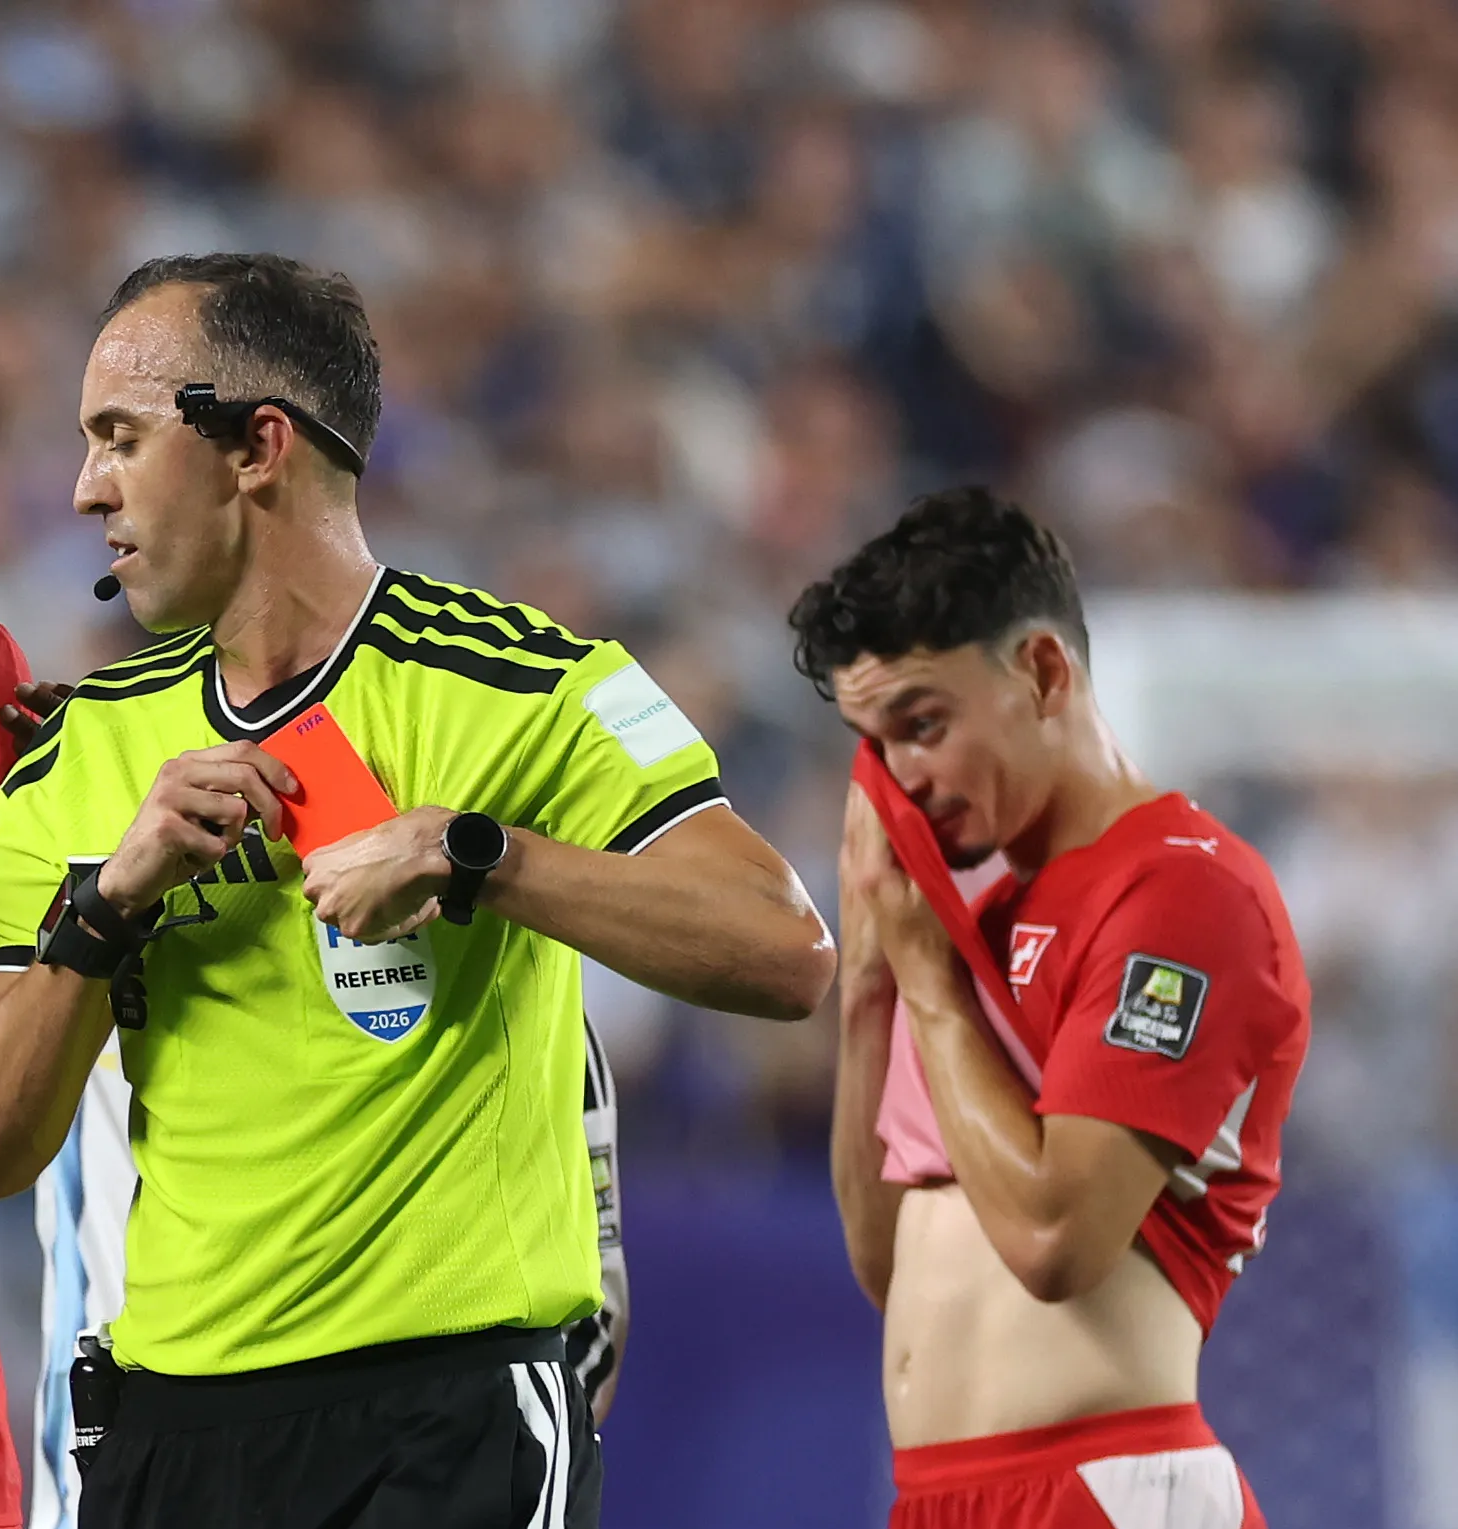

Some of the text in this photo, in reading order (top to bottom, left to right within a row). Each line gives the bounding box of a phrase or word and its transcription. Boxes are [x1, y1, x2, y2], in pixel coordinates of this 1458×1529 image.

[296, 714, 324, 736] FIFA
[334, 963, 427, 989] REFEREE
[368, 1011, 410, 1031] 2026
